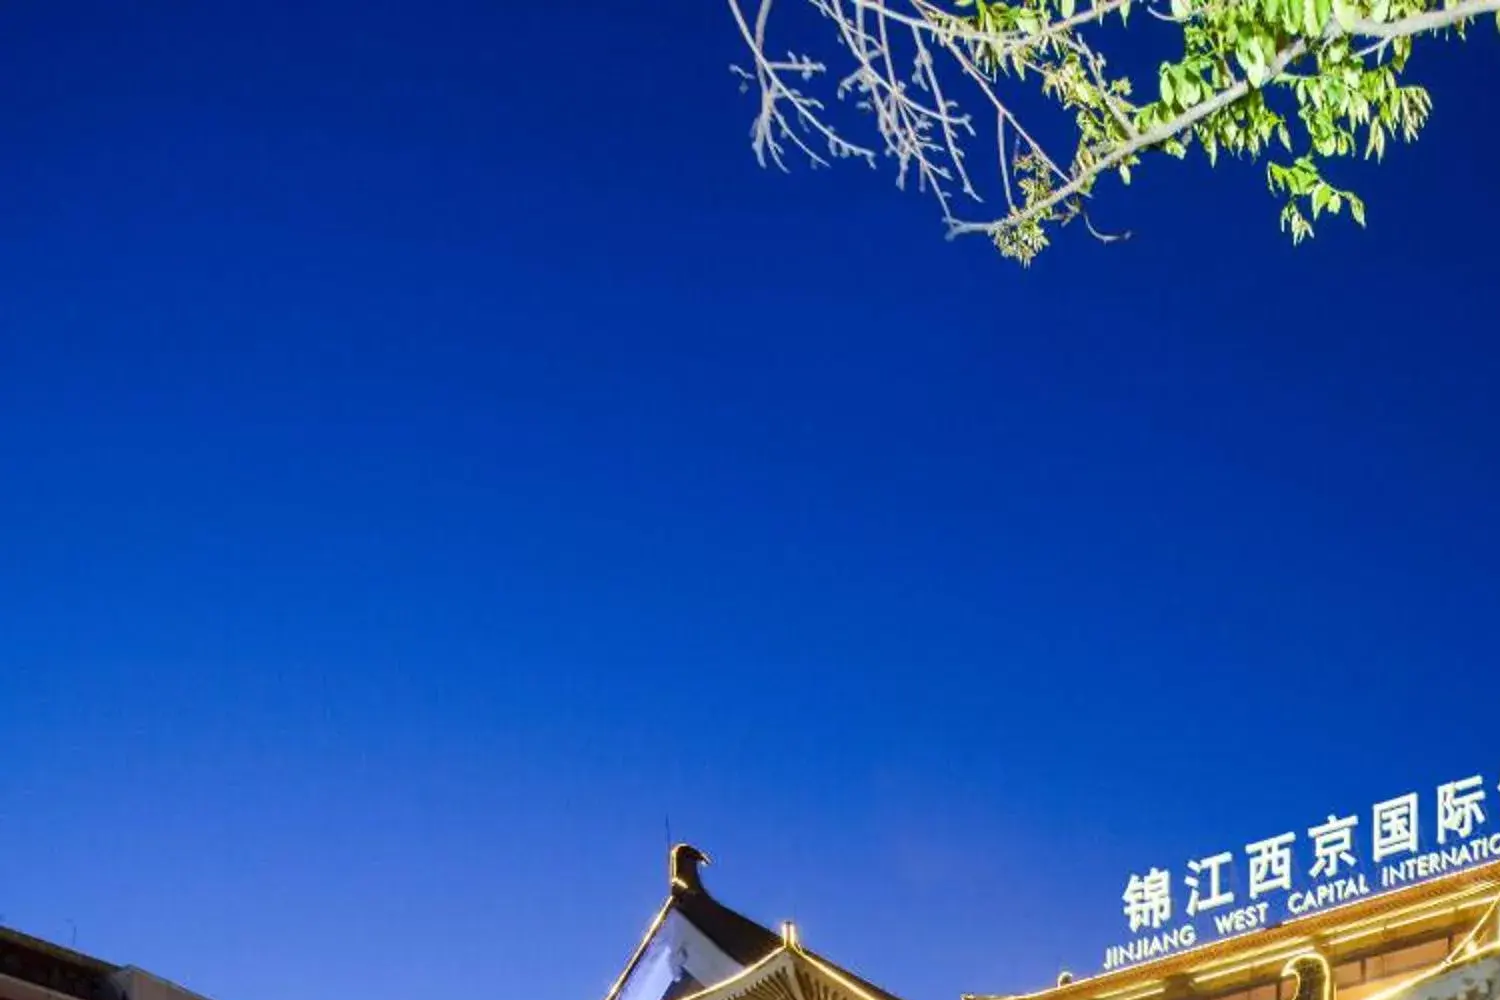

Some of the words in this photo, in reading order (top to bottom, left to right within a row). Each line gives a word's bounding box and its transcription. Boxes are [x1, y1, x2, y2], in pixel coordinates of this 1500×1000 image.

[1103, 925, 1197, 970] JINJIANG
[1213, 901, 1269, 936] WEST
[1286, 872, 1370, 914] CAPITAL
